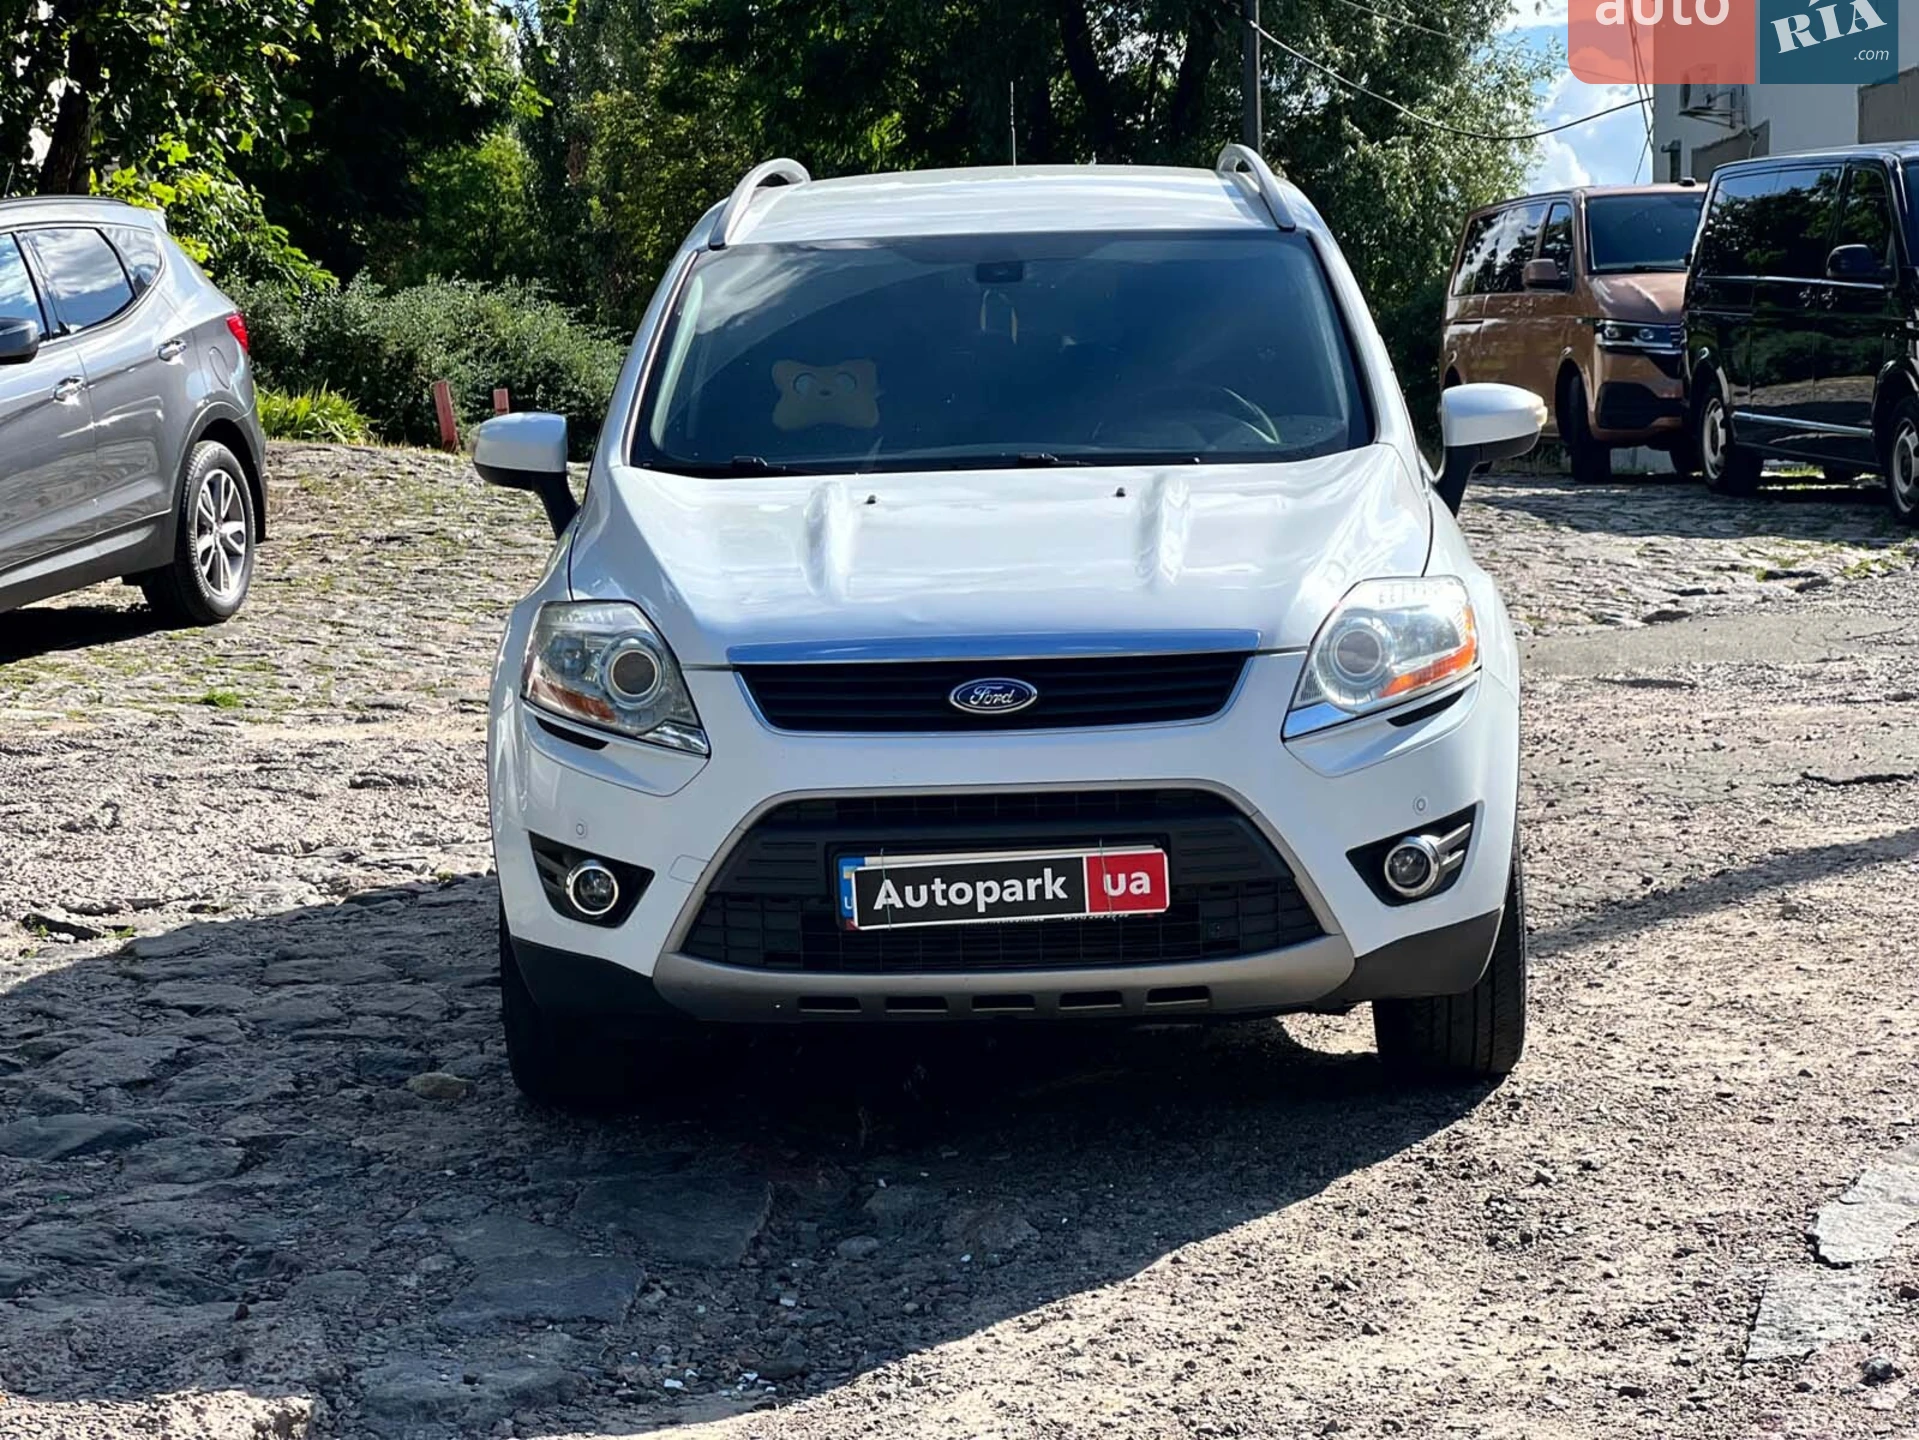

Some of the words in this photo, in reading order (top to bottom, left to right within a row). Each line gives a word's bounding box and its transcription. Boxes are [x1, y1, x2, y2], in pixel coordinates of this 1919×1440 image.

[969, 685, 1015, 705] Ford
[873, 867, 1068, 913] Autopark
[1103, 870, 1151, 896] ua
